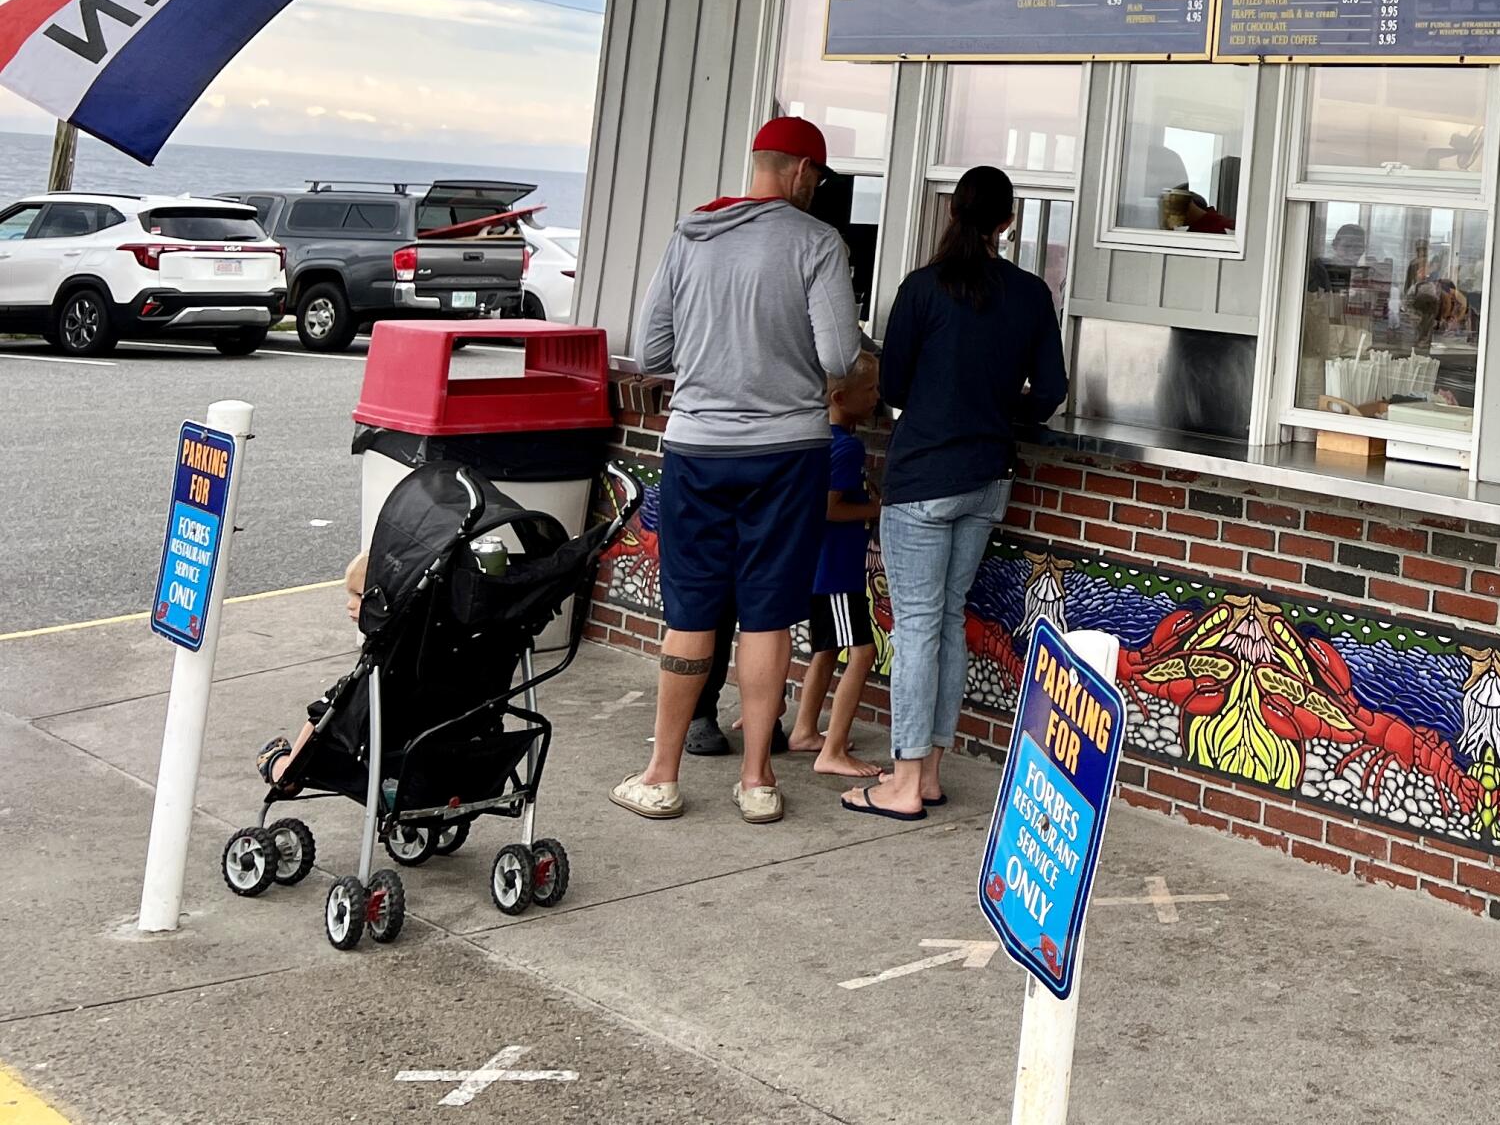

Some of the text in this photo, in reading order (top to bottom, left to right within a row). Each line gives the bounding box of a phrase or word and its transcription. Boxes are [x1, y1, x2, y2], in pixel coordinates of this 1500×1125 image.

[1380, 20, 1397, 31] 5.95
[181, 439, 228, 479] PARKING
[189, 474, 211, 505] FOR
[178, 516, 210, 546] FORBES
[171, 538, 211, 566] RESTAURANT
[174, 560, 200, 583] SERVICE
[169, 581, 197, 611] ONLY
[1034, 644, 1112, 754] PARKING
[1045, 709, 1081, 775] FOR
[1025, 760, 1080, 842] FORBES
[1013, 785, 1080, 875] RESTAURANT
[1016, 825, 1060, 890] SERVICE
[1006, 855, 1054, 927] ONLY
